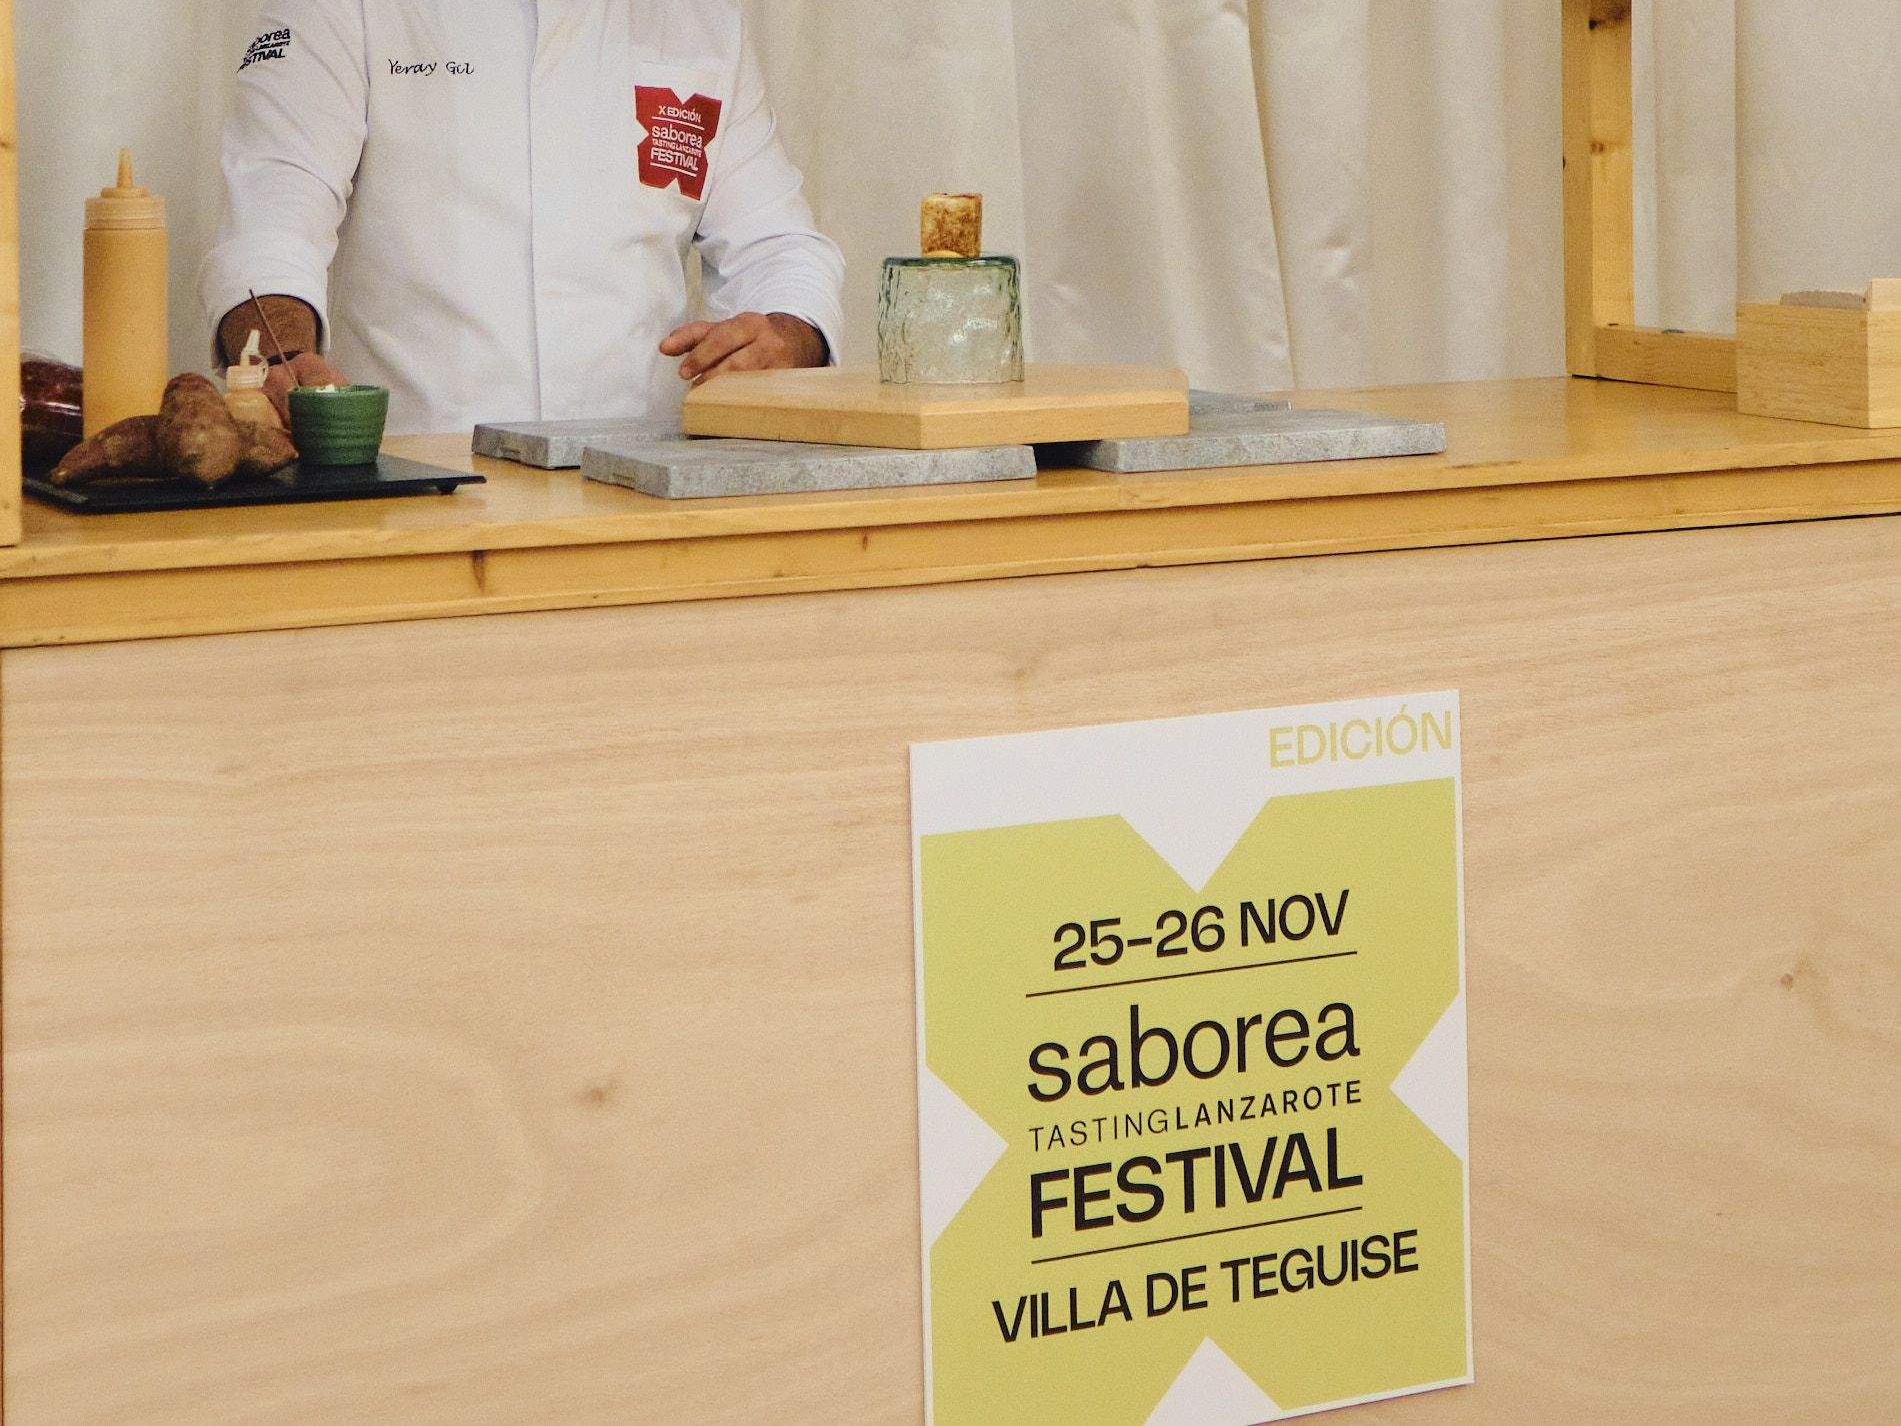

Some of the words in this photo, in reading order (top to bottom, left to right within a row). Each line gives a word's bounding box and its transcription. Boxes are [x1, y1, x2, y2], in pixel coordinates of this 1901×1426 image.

[388, 58, 437, 76] Yeray
[651, 123, 703, 149] saborea
[658, 105, 666, 115] X
[667, 106, 702, 124] EDICIÓN
[650, 147, 699, 171] FESTIVAL
[1268, 704, 1453, 769] EDICIÓN
[1240, 888, 1350, 948] NOV
[1026, 1002, 1361, 1103] saborea
[1028, 1079, 1362, 1152] TASTINGLANZAROTE
[1029, 1127, 1363, 1239] FESTIVAL
[992, 1279, 1133, 1343] VILLA
[1146, 1265, 1208, 1318] DE
[1220, 1229, 1419, 1303] TEGUISE
